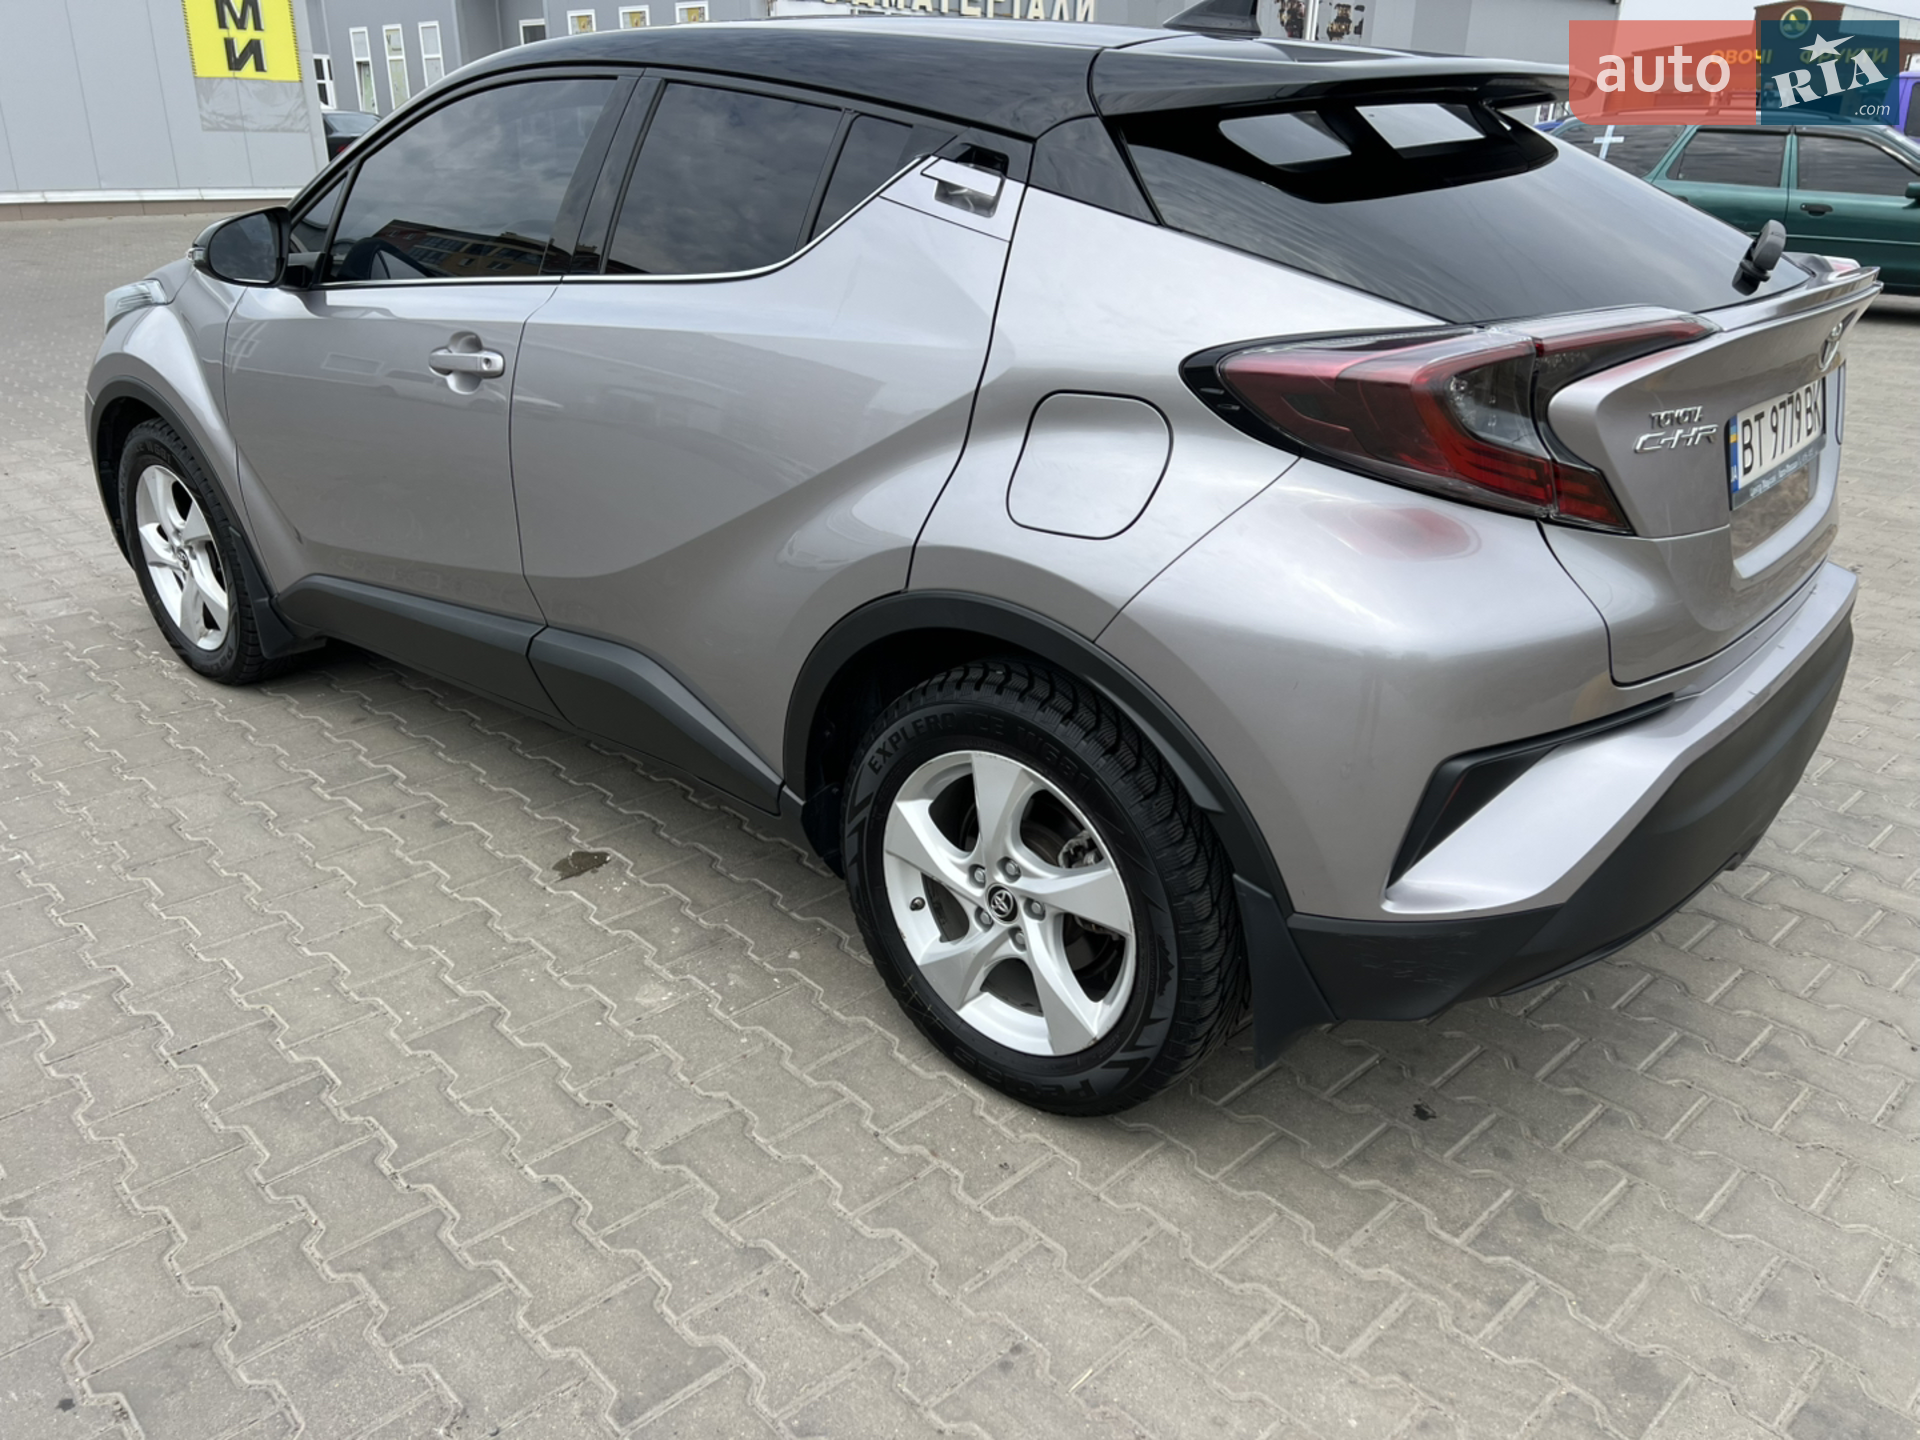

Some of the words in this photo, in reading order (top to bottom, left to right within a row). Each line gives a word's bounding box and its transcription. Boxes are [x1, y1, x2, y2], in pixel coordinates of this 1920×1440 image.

[1709, 48, 1773, 65] ОВОЧІ
[1741, 411, 1765, 476] BT
[1769, 392, 1802, 460] 9779
[866, 711, 957, 776] EXPLERO
